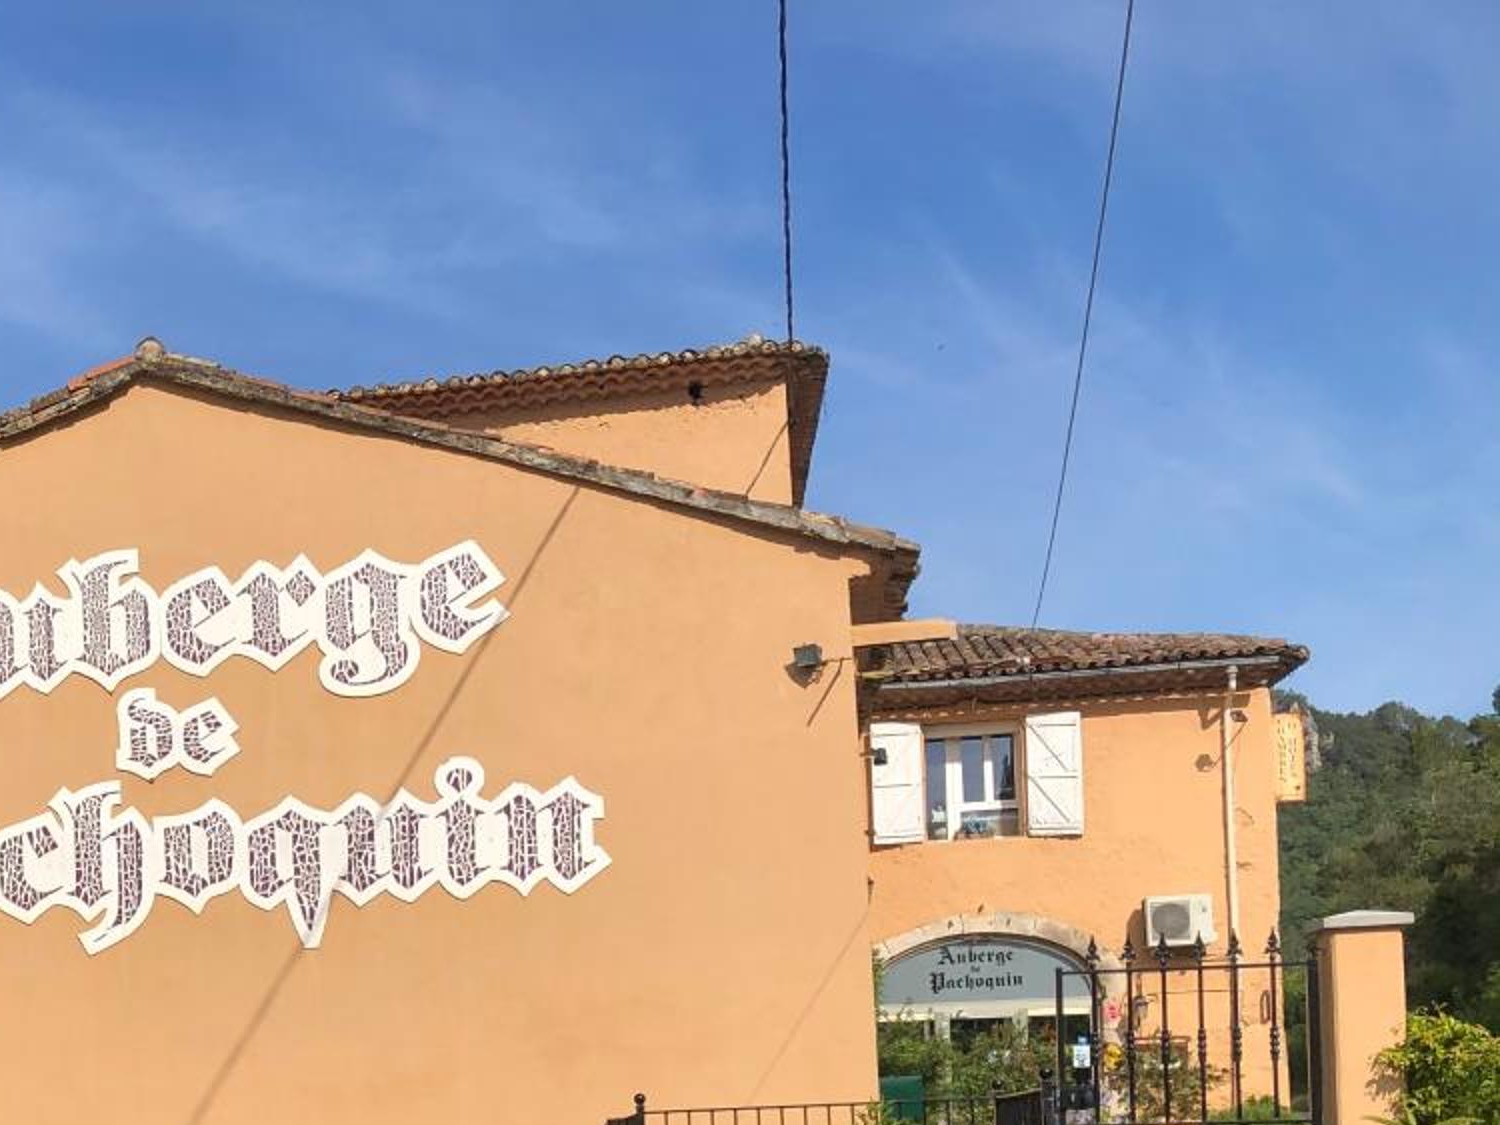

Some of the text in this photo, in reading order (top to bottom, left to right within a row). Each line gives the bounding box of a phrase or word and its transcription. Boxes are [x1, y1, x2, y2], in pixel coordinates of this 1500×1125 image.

[117, 688, 239, 778] de
[938, 945, 1013, 966] Auberge
[930, 971, 1023, 994] Pachoquin
